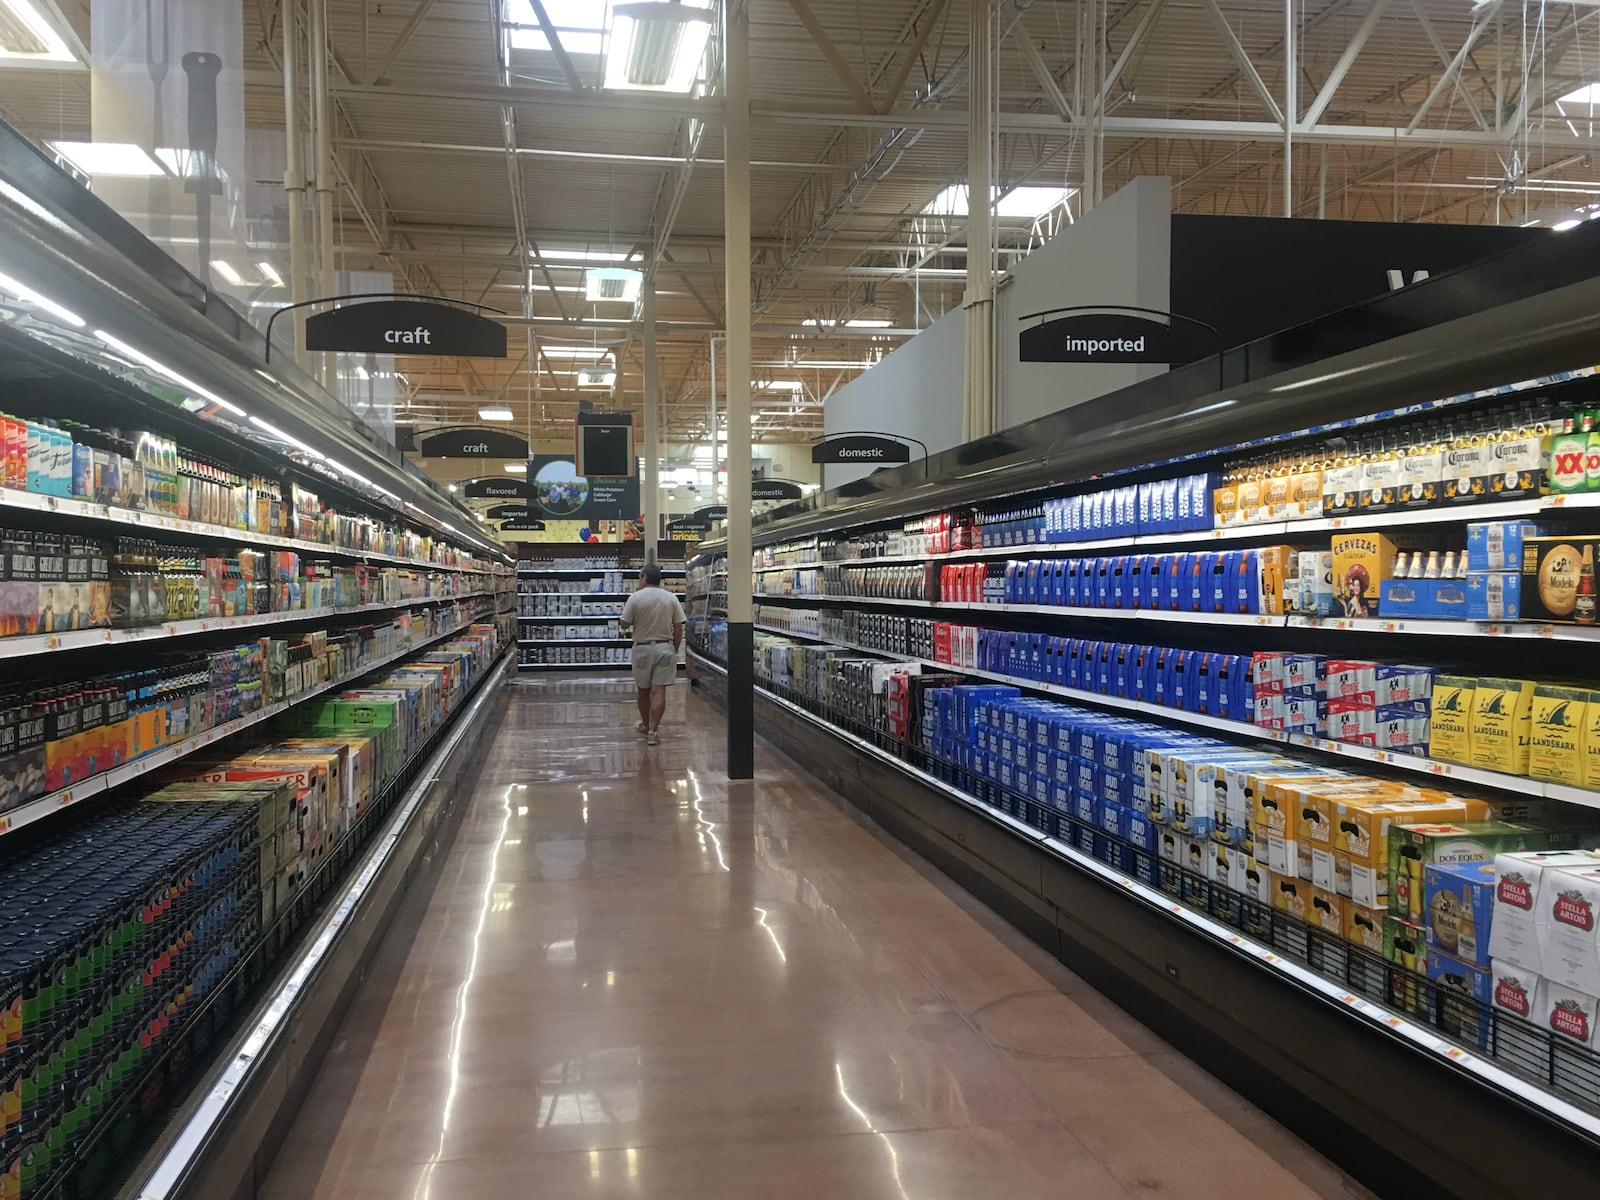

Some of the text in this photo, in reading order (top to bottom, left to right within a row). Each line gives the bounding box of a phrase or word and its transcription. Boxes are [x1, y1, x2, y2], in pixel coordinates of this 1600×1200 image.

[384, 326, 431, 345] craft
[1066, 335, 1145, 355] imported
[463, 443, 488, 453] craft
[838, 447, 884, 458] domestic
[1495, 444, 1527, 459] Corona
[1448, 450, 1480, 465] Corona
[1554, 452, 1584, 475] XX
[486, 487, 517, 496] flavored
[1334, 538, 1377, 555] CERVEZAS
[1550, 575, 1574, 589] Modelo
[1432, 722, 1465, 733] LANDSHARK
[1474, 726, 1509, 738] LANDSHARK
[1105, 742, 1117, 756] BUD
[1532, 737, 1575, 751] LANDSHARK
[1103, 755, 1118, 769] LIGHT
[1133, 750, 1145, 763] BU
[1131, 762, 1145, 778] LIGH
[1105, 774, 1117, 789] BUD
[1103, 786, 1119, 803] LIGHT
[1131, 795, 1145, 812] LIGH
[1105, 807, 1117, 822] BUD
[1103, 819, 1118, 834] LIGHT
[1131, 818, 1145, 835] BUD
[1129, 831, 1146, 848] LIGHT
[1439, 853, 1484, 863] DOS EQUIS
[1473, 885, 1481, 894] 12
[1503, 881, 1527, 897] STELLA
[1502, 890, 1527, 905] ARTOIS
[1560, 900, 1586, 917] STELLA
[1559, 909, 1586, 925] ARTOIS
[1474, 972, 1482, 981] 12
[1501, 986, 1523, 1002] STELLA
[1500, 995, 1523, 1010] ARTOIS
[1557, 1010, 1582, 1027] STELLA
[1556, 1019, 1582, 1036] ARTOIS
